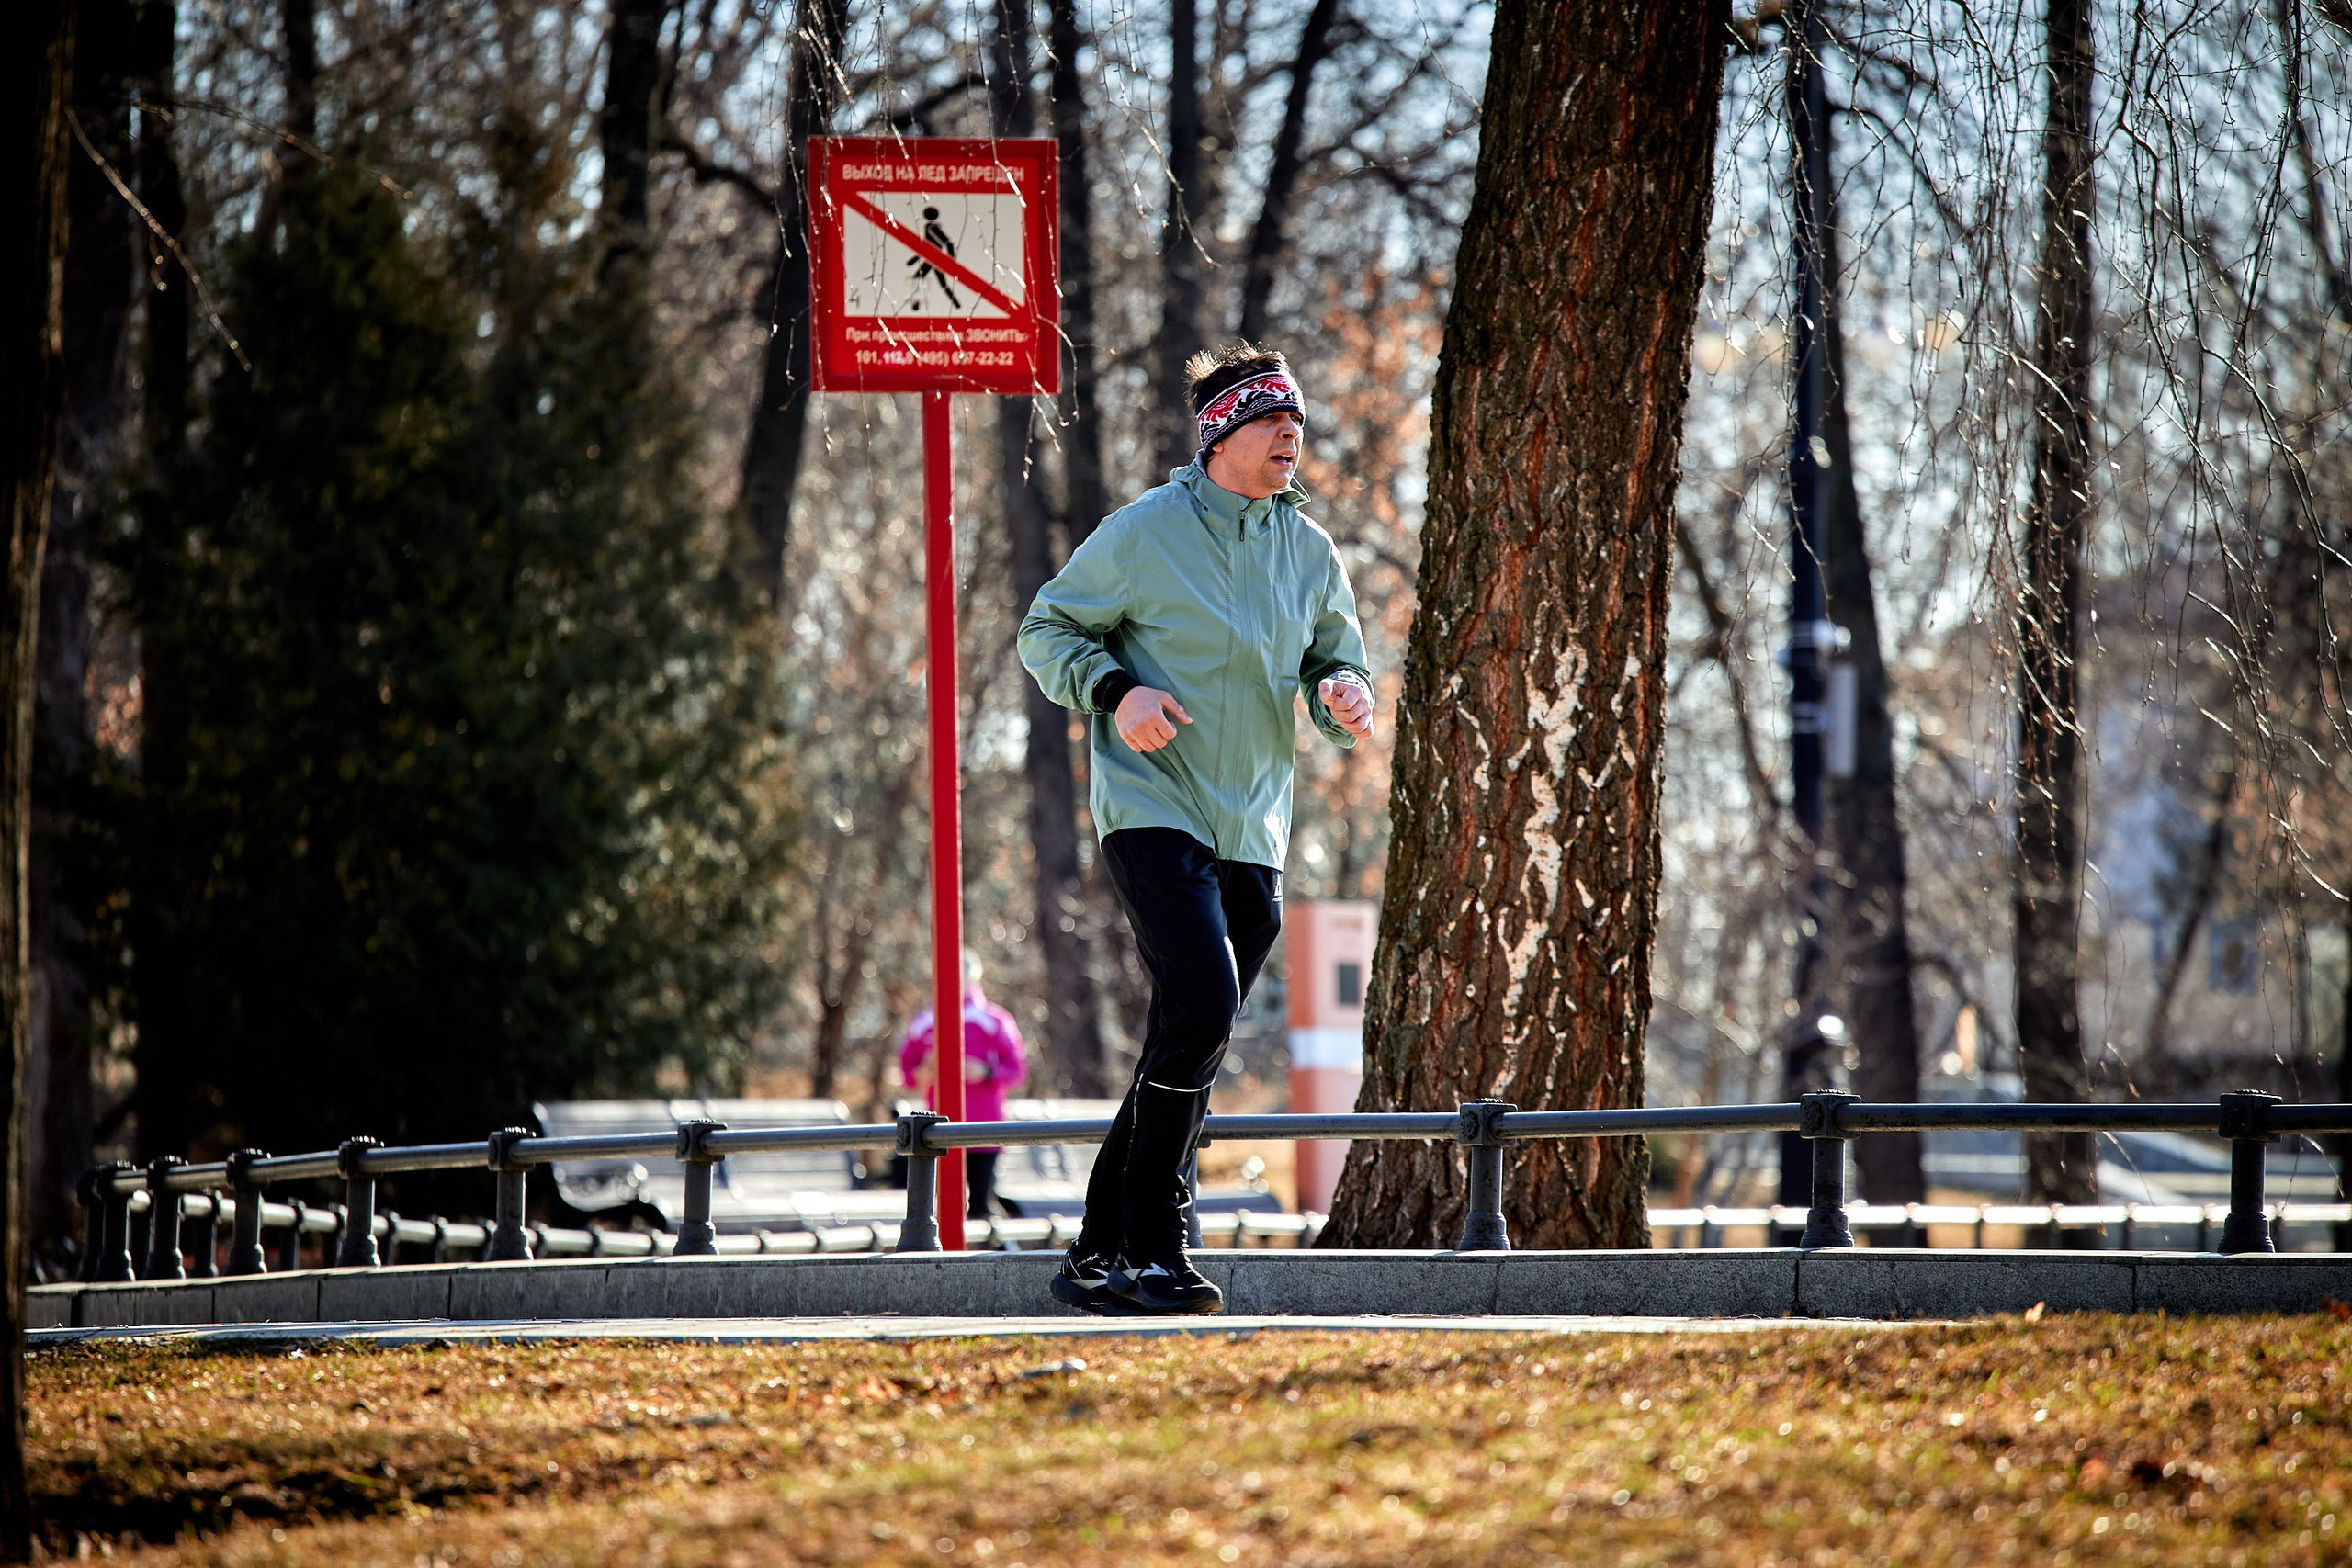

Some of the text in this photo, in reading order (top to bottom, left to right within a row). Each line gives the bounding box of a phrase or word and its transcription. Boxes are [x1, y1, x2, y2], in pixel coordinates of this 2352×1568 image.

[842, 163, 894, 183] ВЫХОД
[896, 164, 915, 181] НА
[845, 326, 871, 344] При
